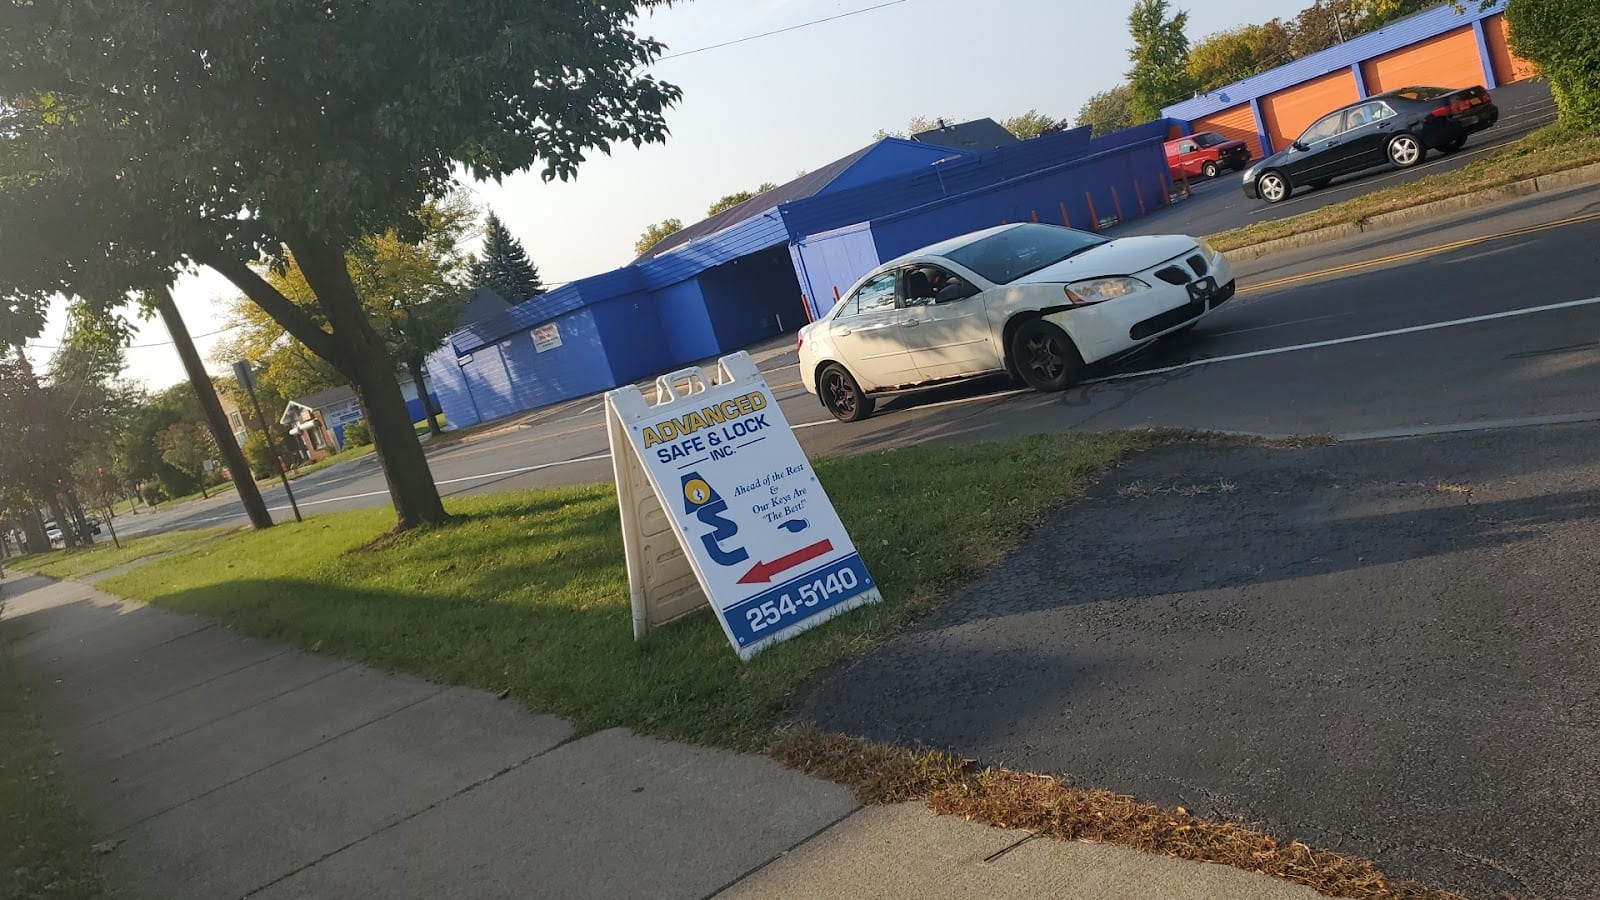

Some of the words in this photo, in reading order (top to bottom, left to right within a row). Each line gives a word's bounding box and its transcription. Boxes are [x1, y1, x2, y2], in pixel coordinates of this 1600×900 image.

[642, 390, 767, 449] ADVANCED
[657, 436, 706, 464] SAFE
[707, 431, 722, 446] &
[722, 413, 771, 441] LOCK
[709, 445, 737, 462] INC.
[734, 478, 761, 497] Ahead
[762, 474, 771, 486] of
[771, 471, 785, 482] the
[785, 463, 804, 476] Rest
[769, 485, 779, 495] &
[752, 503, 769, 514] Our
[770, 496, 792, 508] Keys
[793, 487, 807, 499] Are
[745, 567, 858, 632] 254-5140
